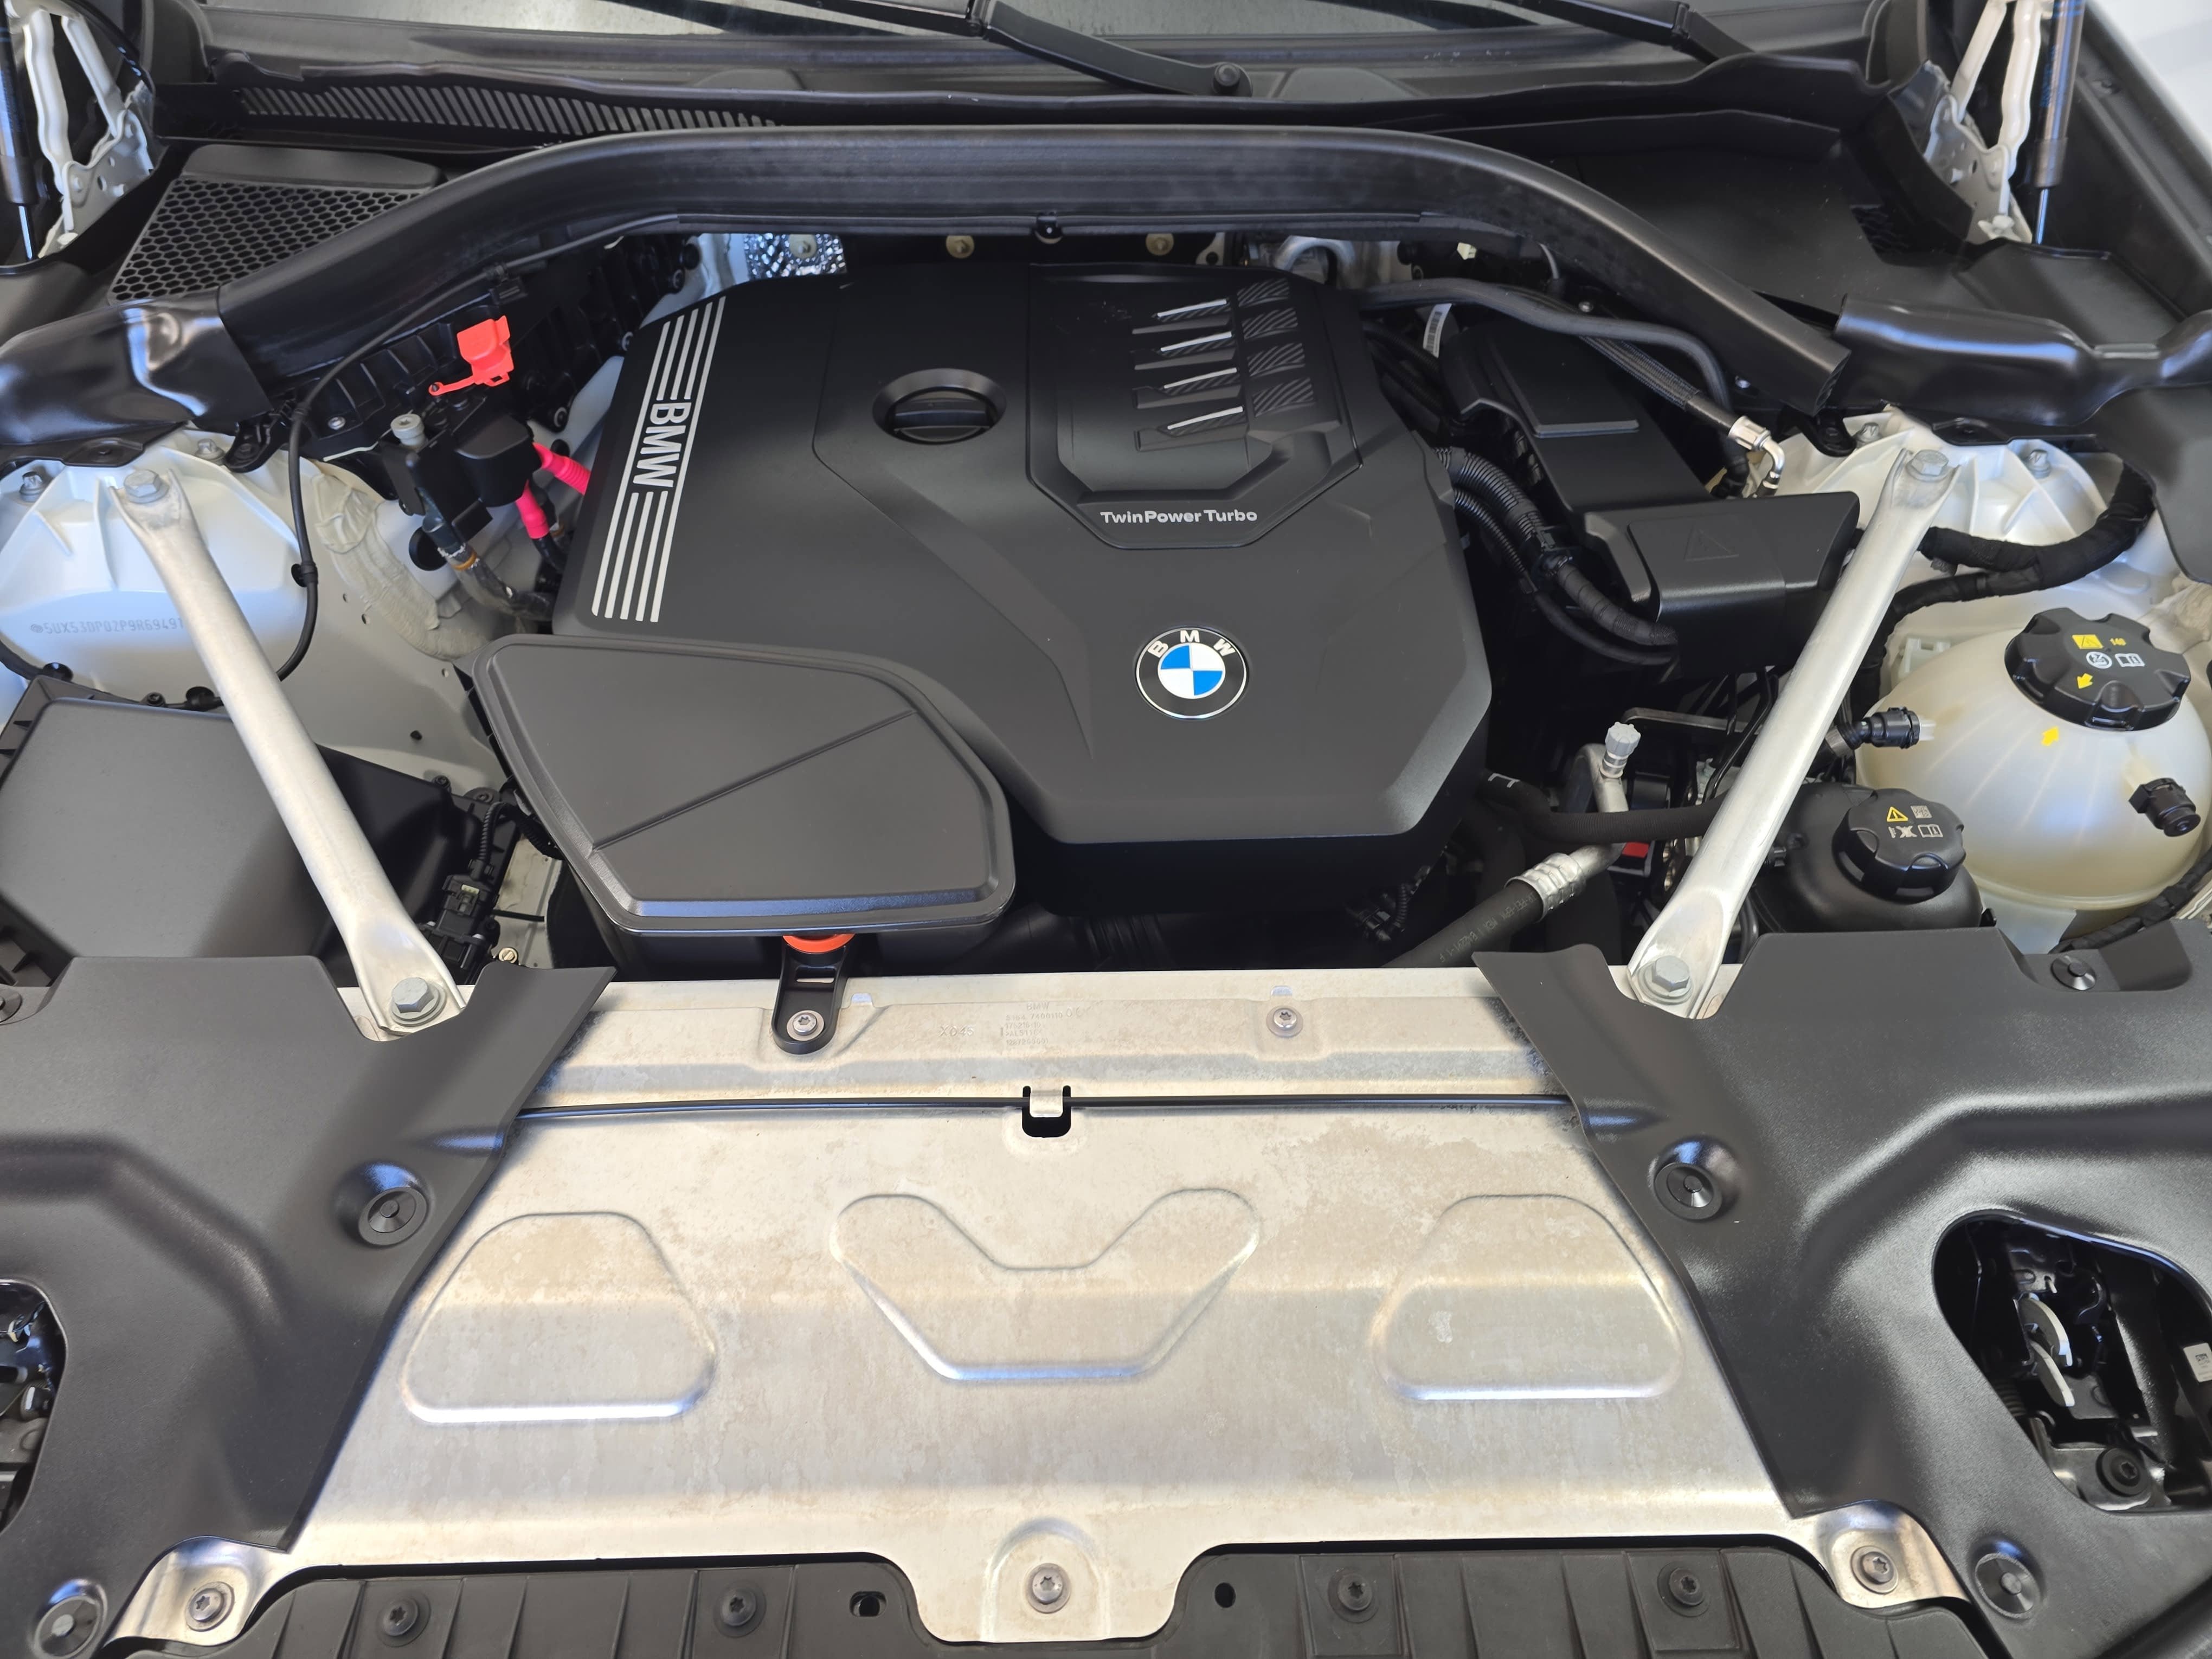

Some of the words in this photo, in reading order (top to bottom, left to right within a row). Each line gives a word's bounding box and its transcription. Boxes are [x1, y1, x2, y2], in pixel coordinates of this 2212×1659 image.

[633, 402, 691, 487] BMW
[1100, 511, 1201, 523] TwinPower
[1203, 509, 1257, 522] Turbo
[1147, 629, 1236, 658] BMW
[1027, 1001, 1050, 1011] BMW
